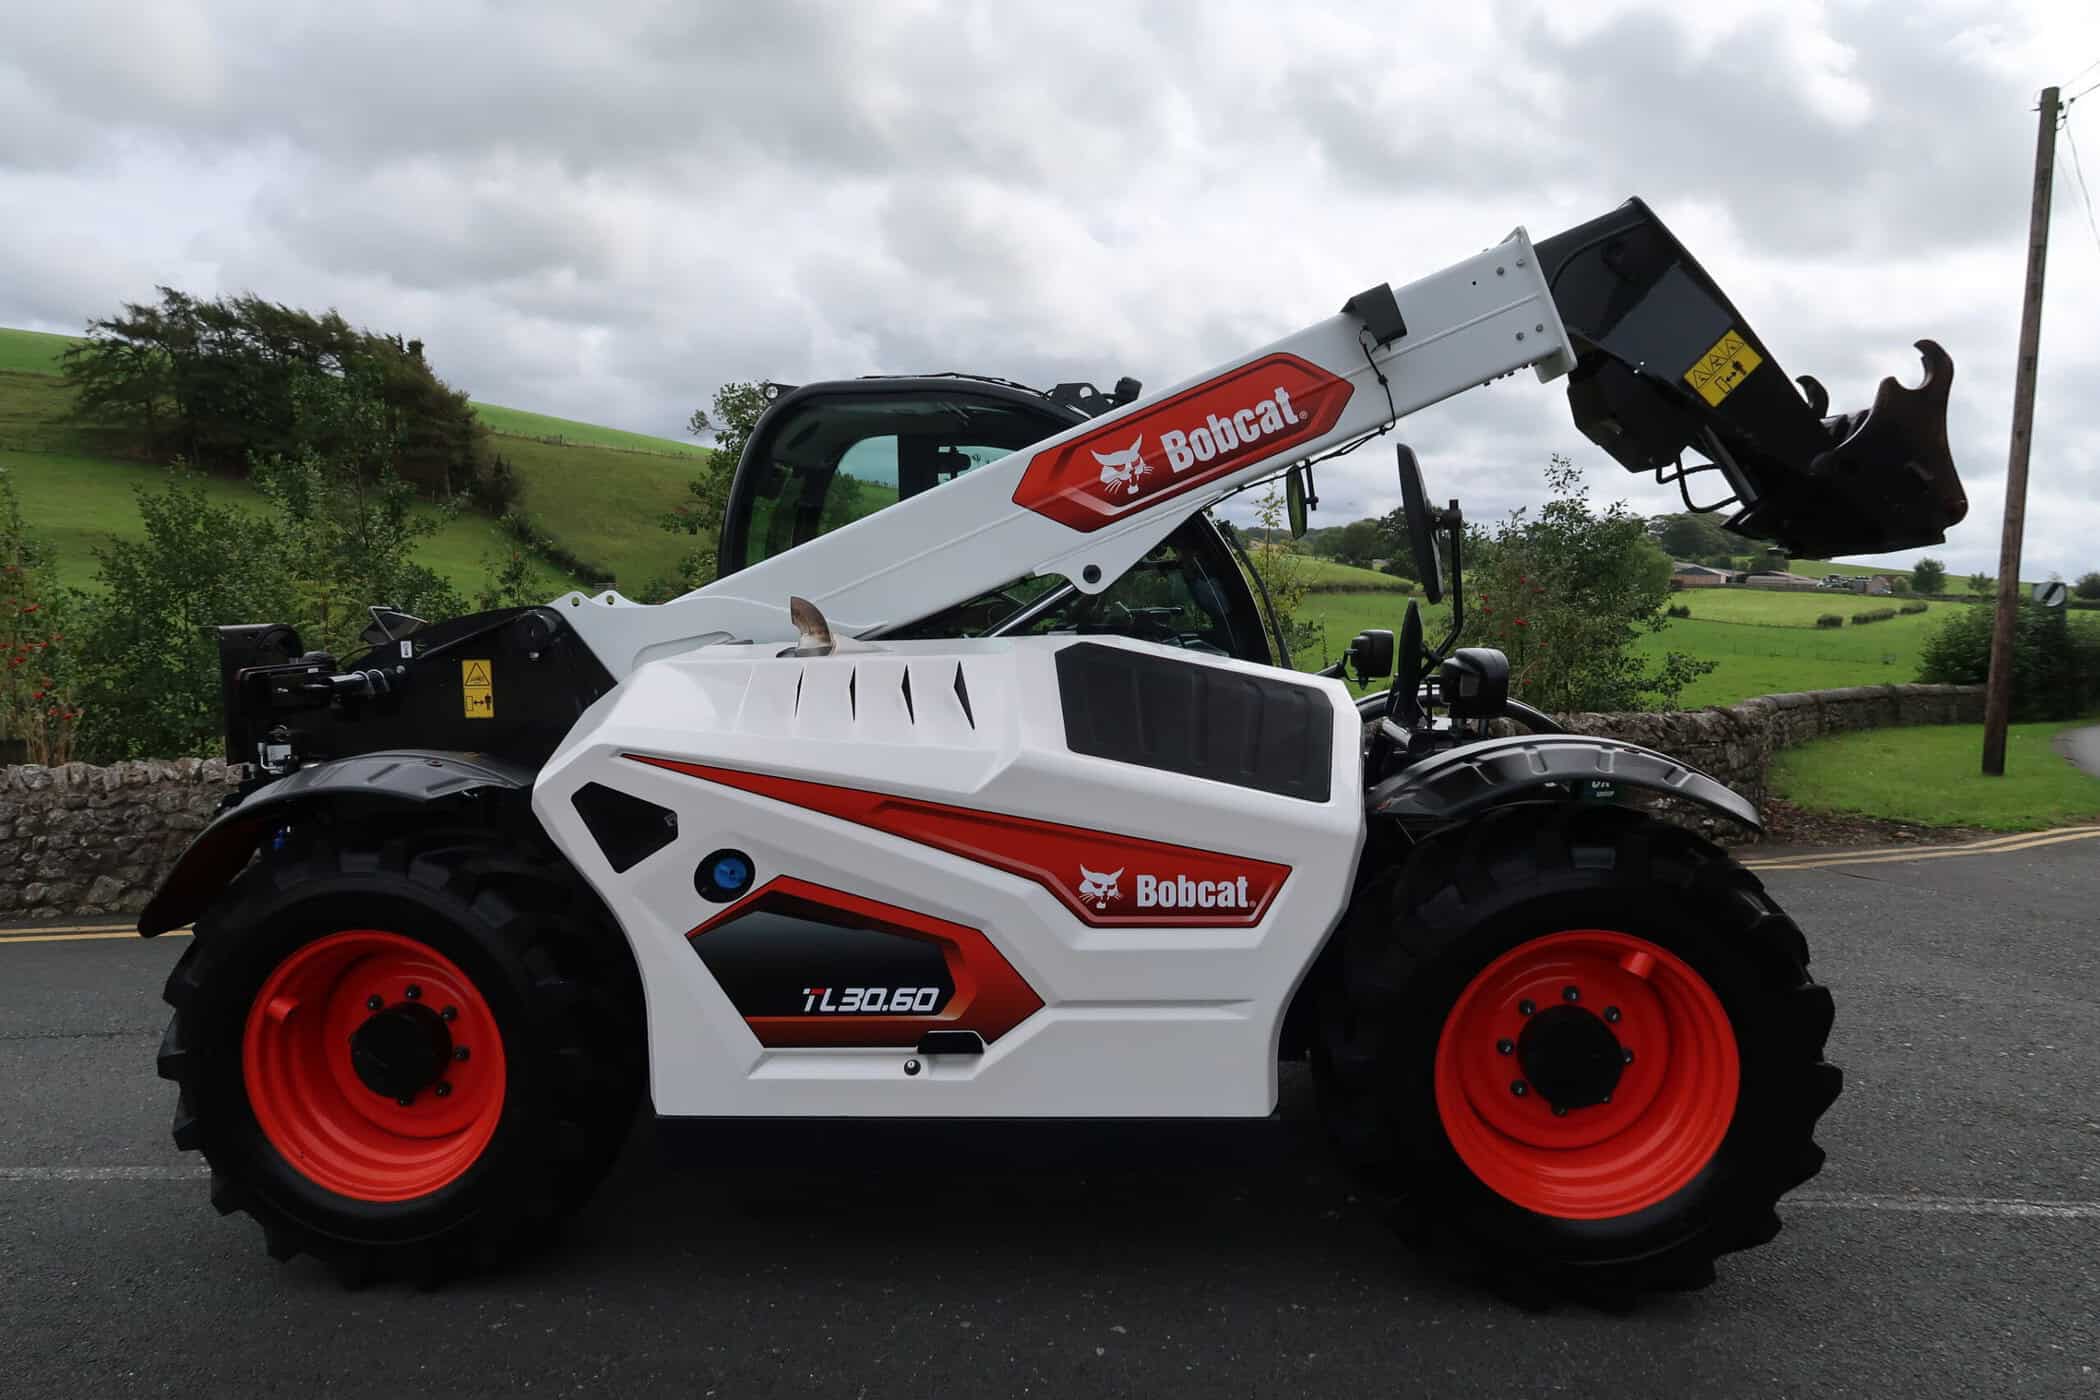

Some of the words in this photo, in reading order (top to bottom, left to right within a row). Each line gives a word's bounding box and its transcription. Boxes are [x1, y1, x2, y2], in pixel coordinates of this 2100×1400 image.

[1160, 387, 1299, 473] Bobcat
[1136, 874, 1249, 908] Bobcat
[802, 987, 940, 1013] TL30.60
